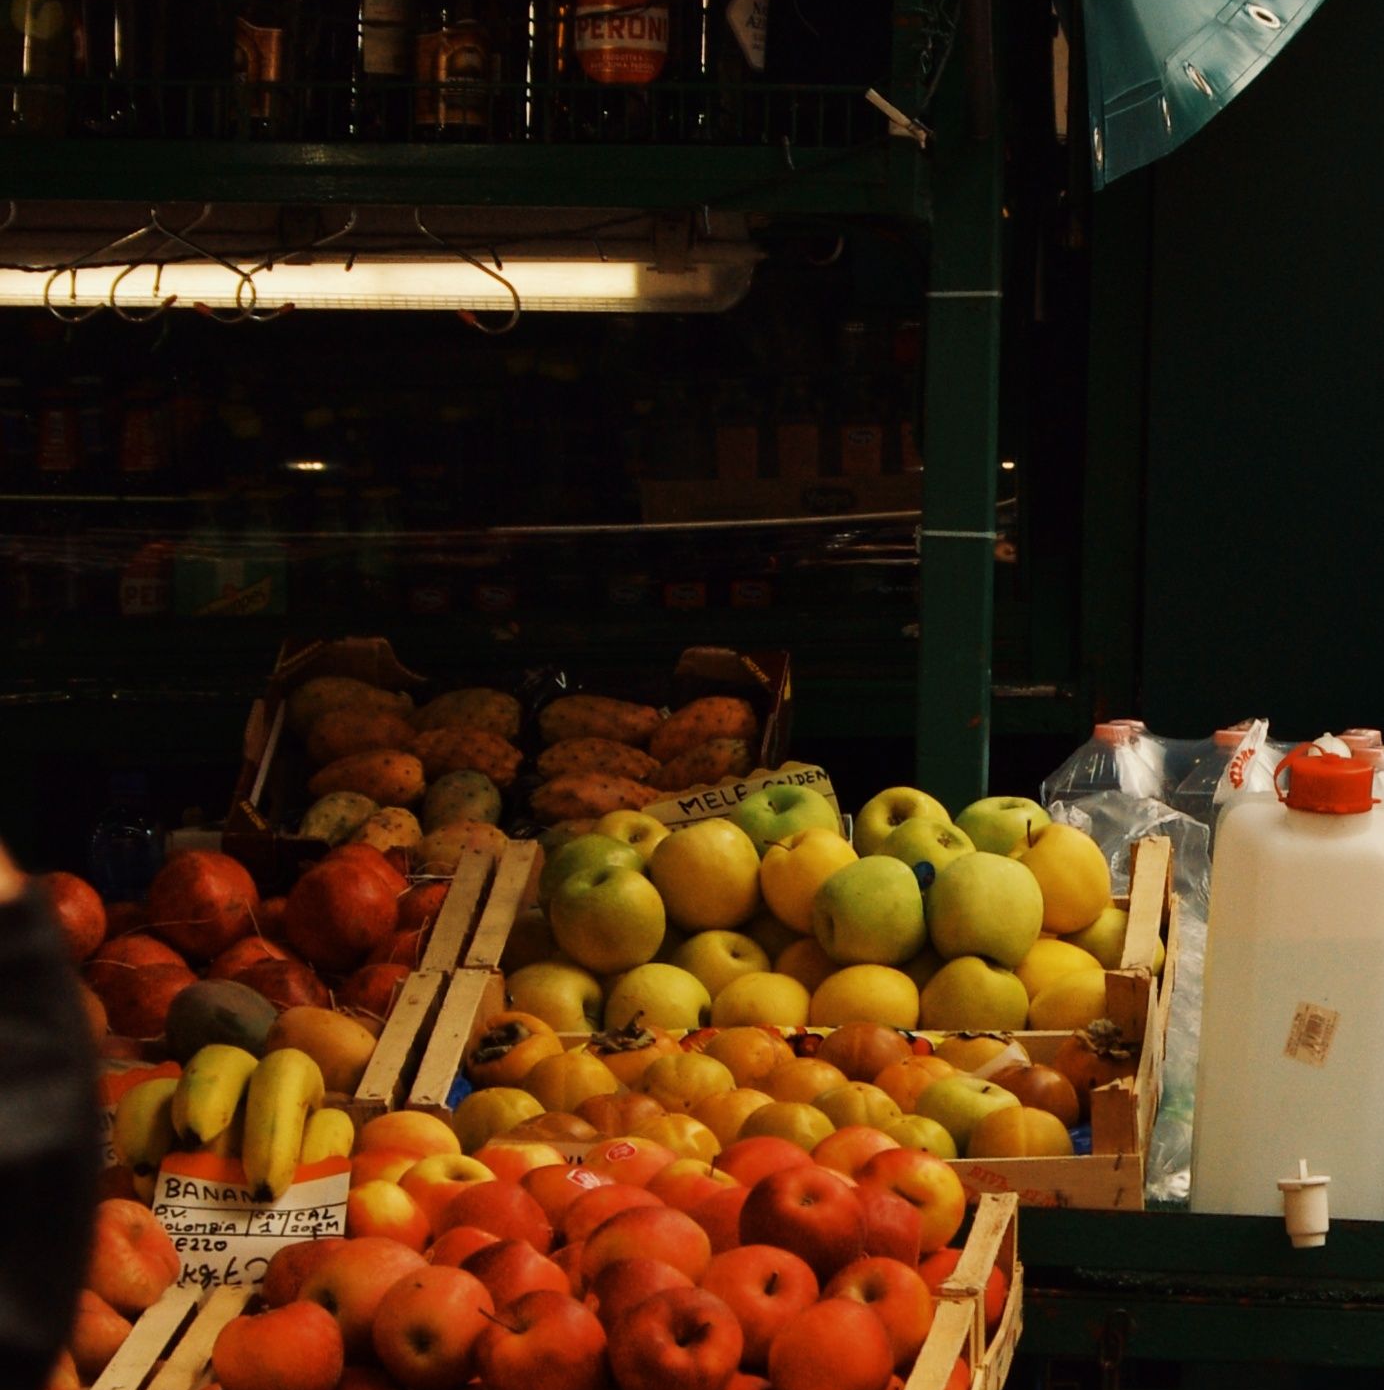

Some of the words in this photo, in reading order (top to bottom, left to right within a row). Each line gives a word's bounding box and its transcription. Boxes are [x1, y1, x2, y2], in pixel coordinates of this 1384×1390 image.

[577, 14, 668, 42] PERONI
[677, 783, 748, 815] MELE
[762, 769, 829, 789] LDEN
[165, 1177, 255, 1203] BANAN
[294, 1208, 337, 1222] CAL
[161, 1220, 237, 1235] OLOMBIA
[259, 1221, 272, 1234] 1
